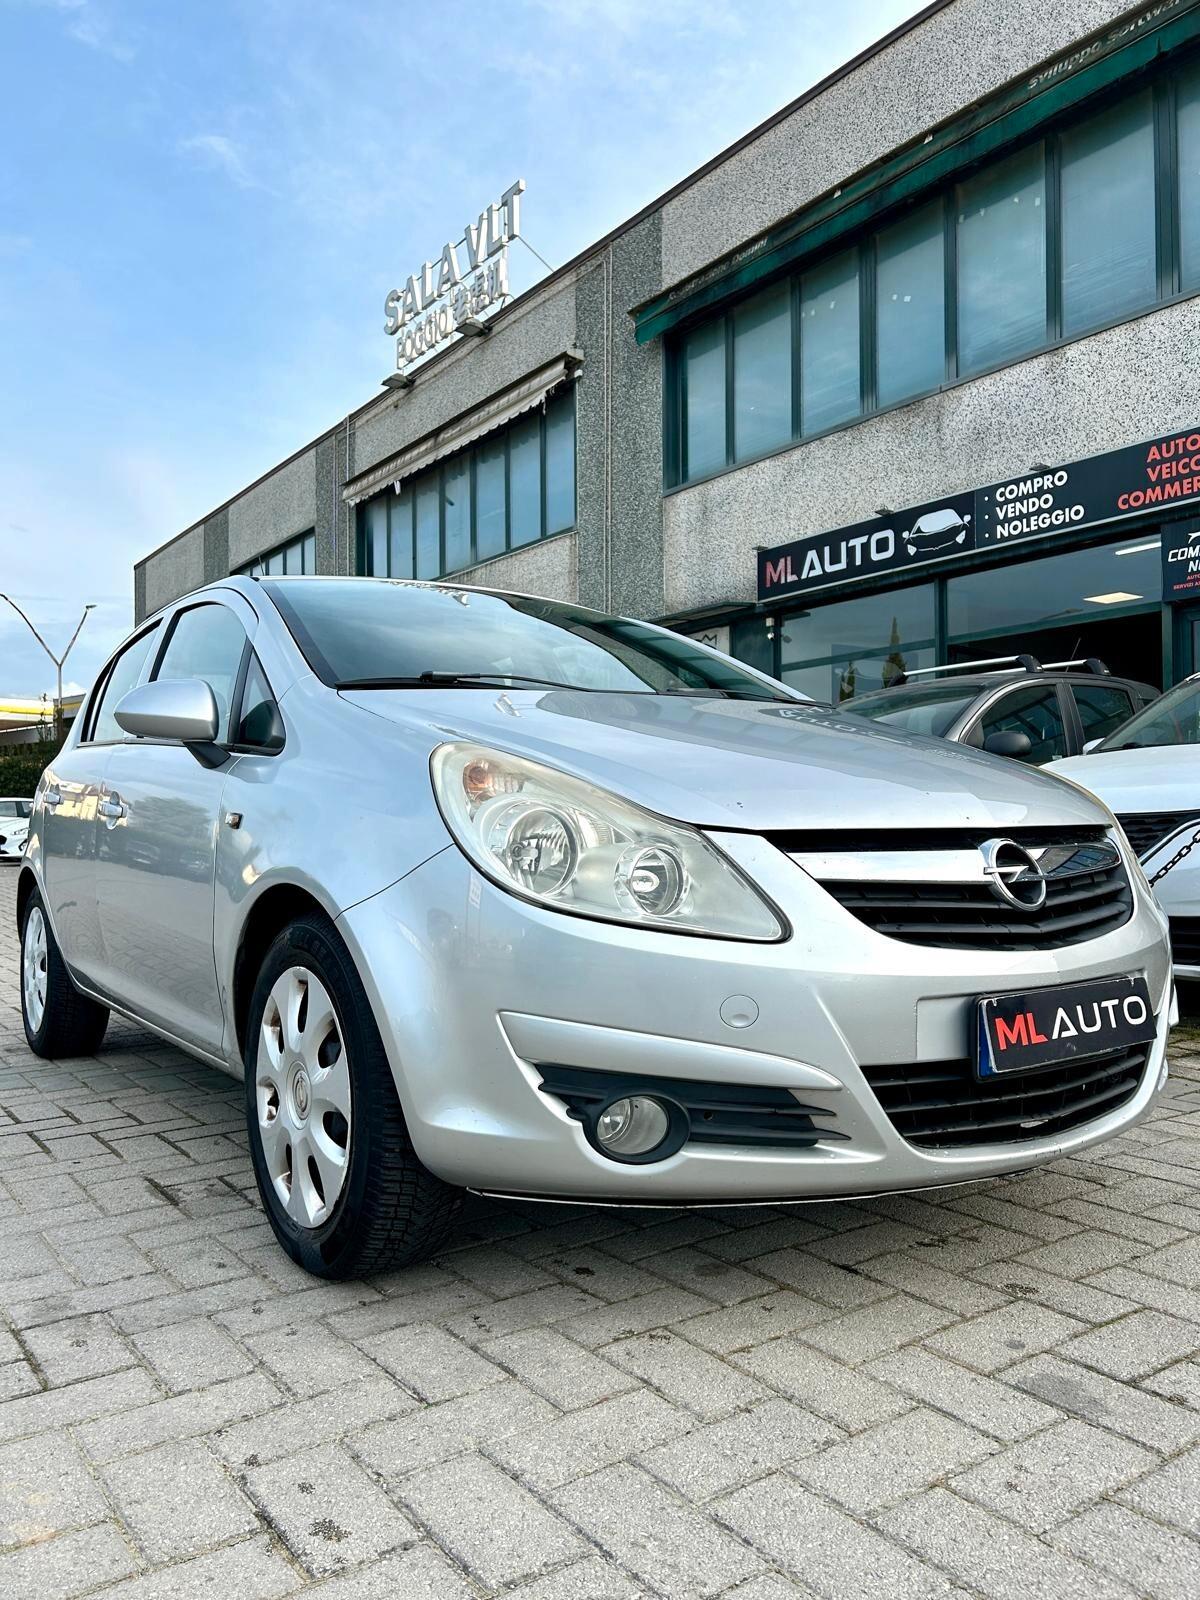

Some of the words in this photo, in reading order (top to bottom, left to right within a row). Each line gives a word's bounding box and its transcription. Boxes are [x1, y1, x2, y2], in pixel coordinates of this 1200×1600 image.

[384, 242, 462, 335] SALA
[464, 179, 526, 270] VLT
[995, 471, 1068, 502] COMPRO
[996, 493, 1054, 520] VENDO
[996, 505, 1085, 539] NOLEGGIO
